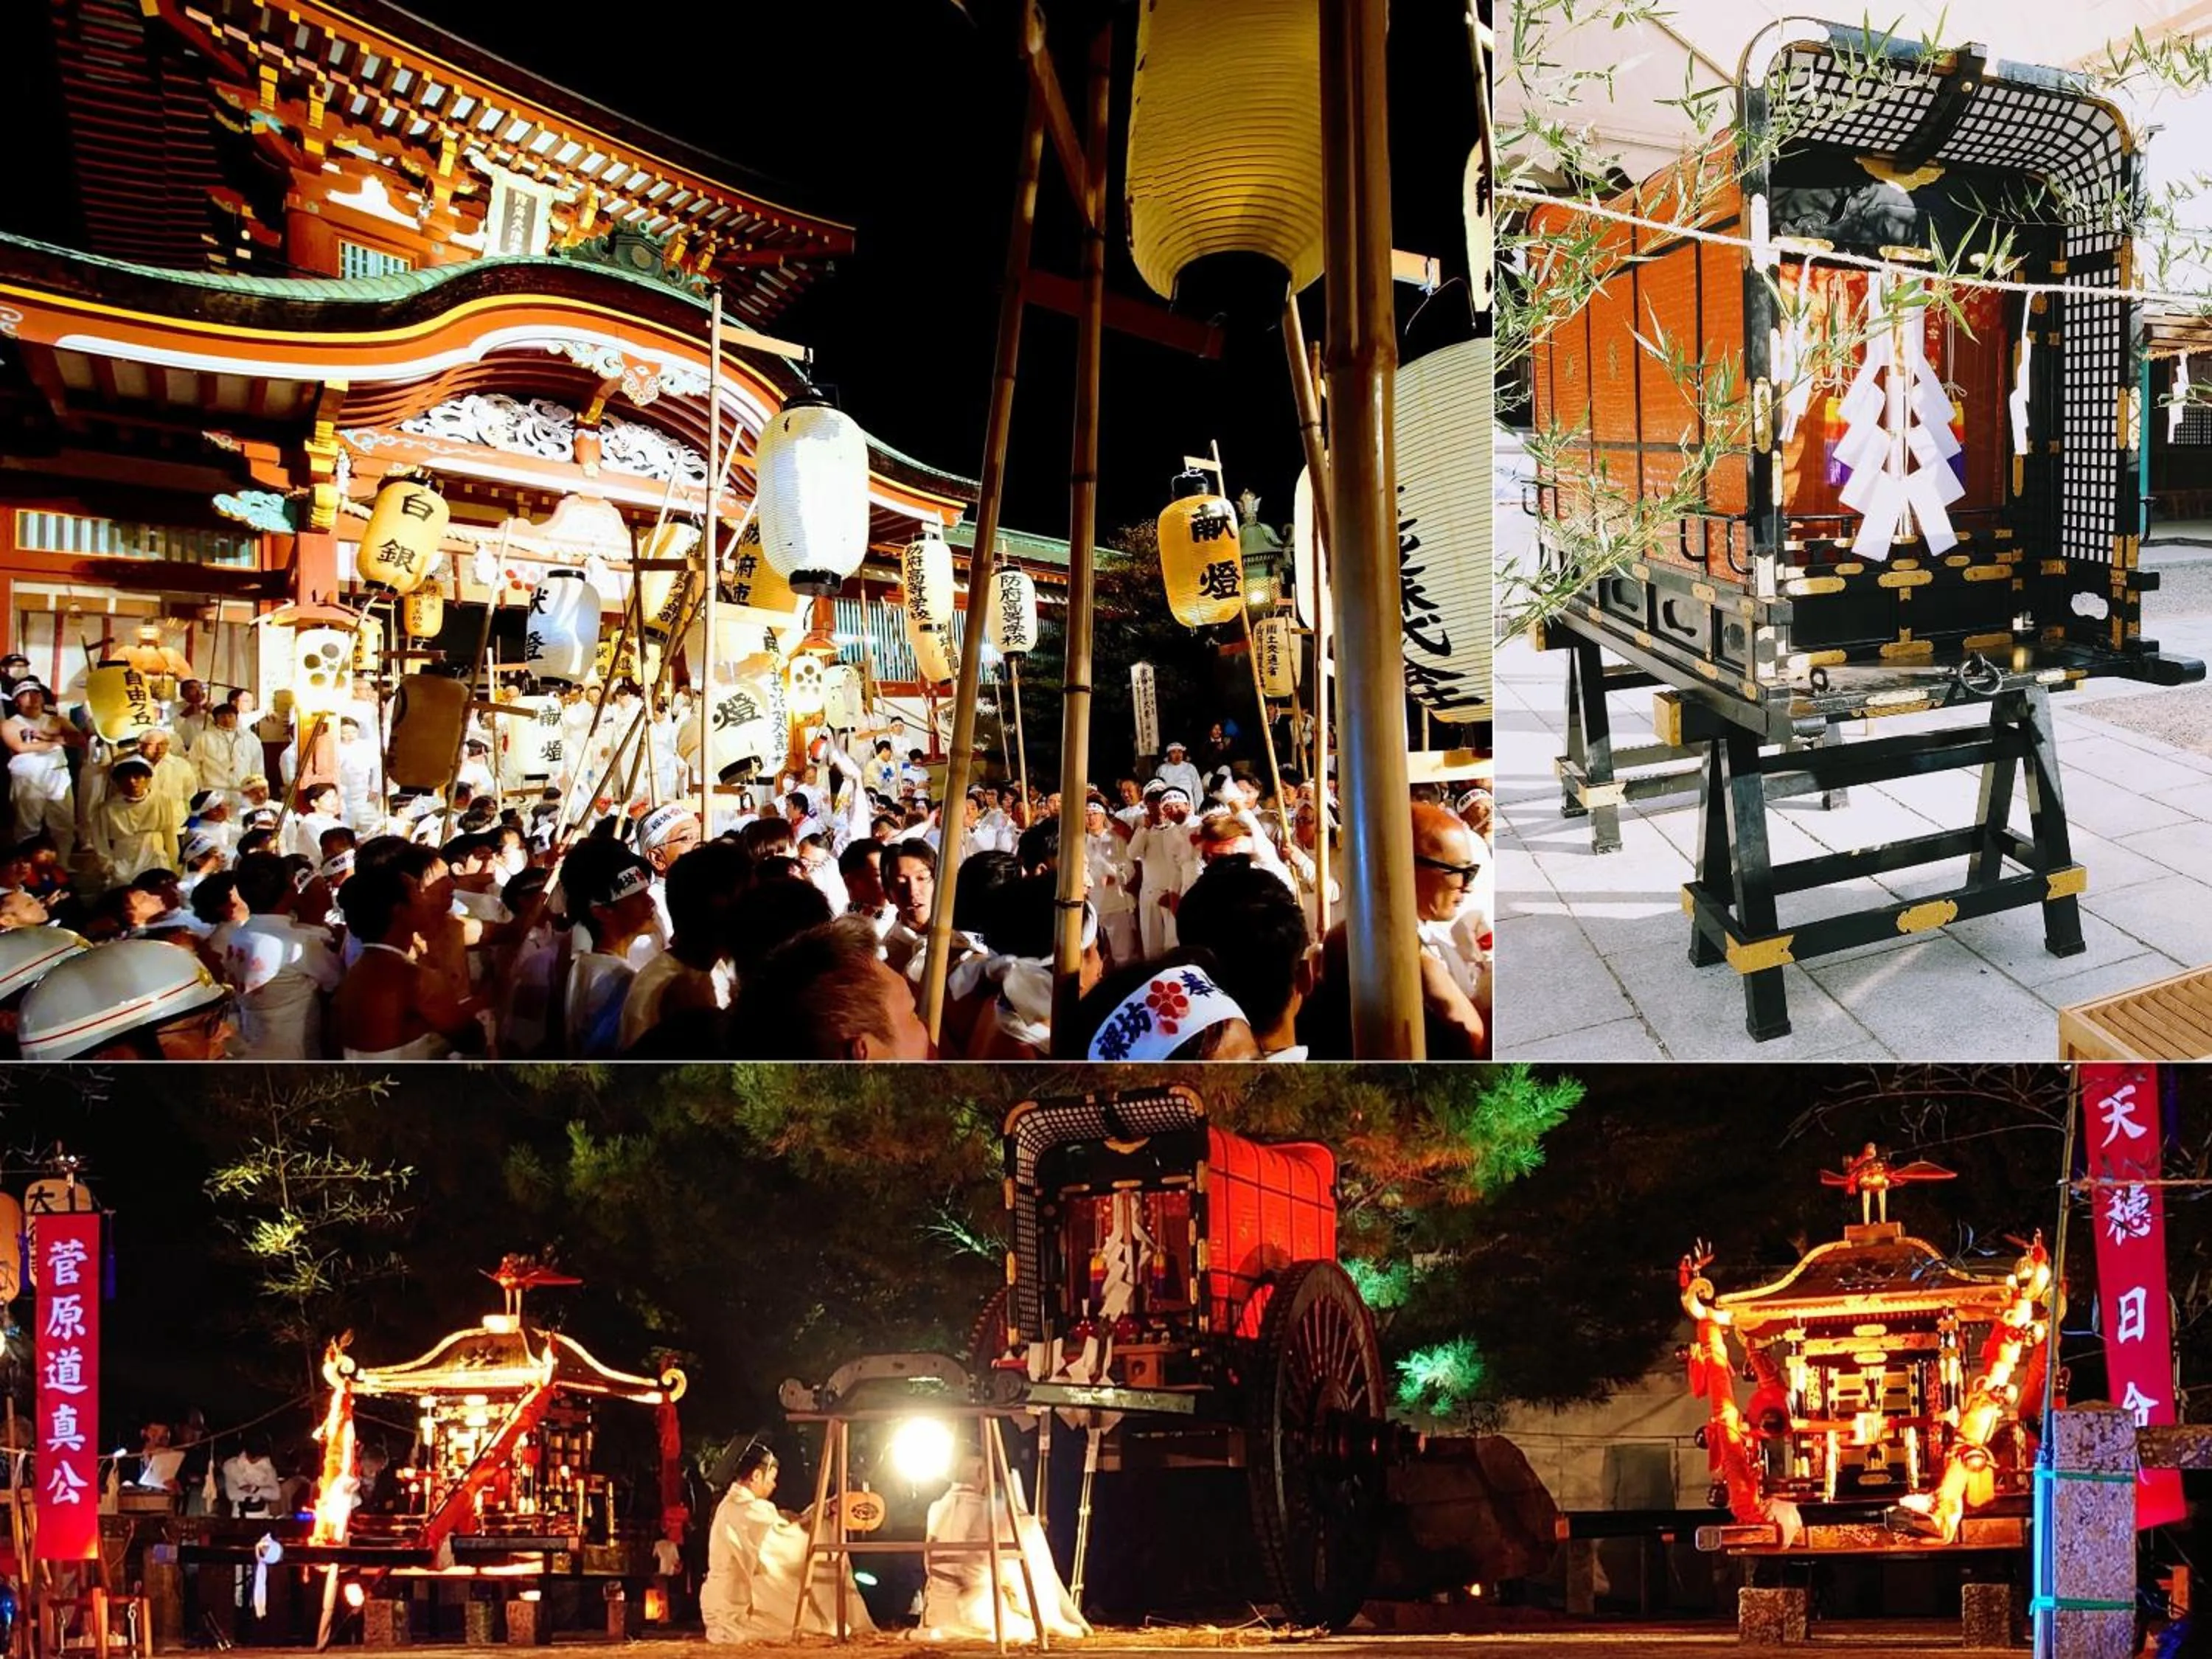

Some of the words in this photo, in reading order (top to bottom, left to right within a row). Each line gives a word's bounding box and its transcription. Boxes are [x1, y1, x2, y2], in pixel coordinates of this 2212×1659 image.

[378, 491, 434, 573] 白銀
[1190, 504, 1240, 600] 献燈
[905, 544, 933, 621] 防府高等学校
[1000, 574, 1028, 646] 防府高等学校
[1096, 1002, 1152, 1060] 裸坊
[44, 1239, 88, 1506] 菅原道真公
